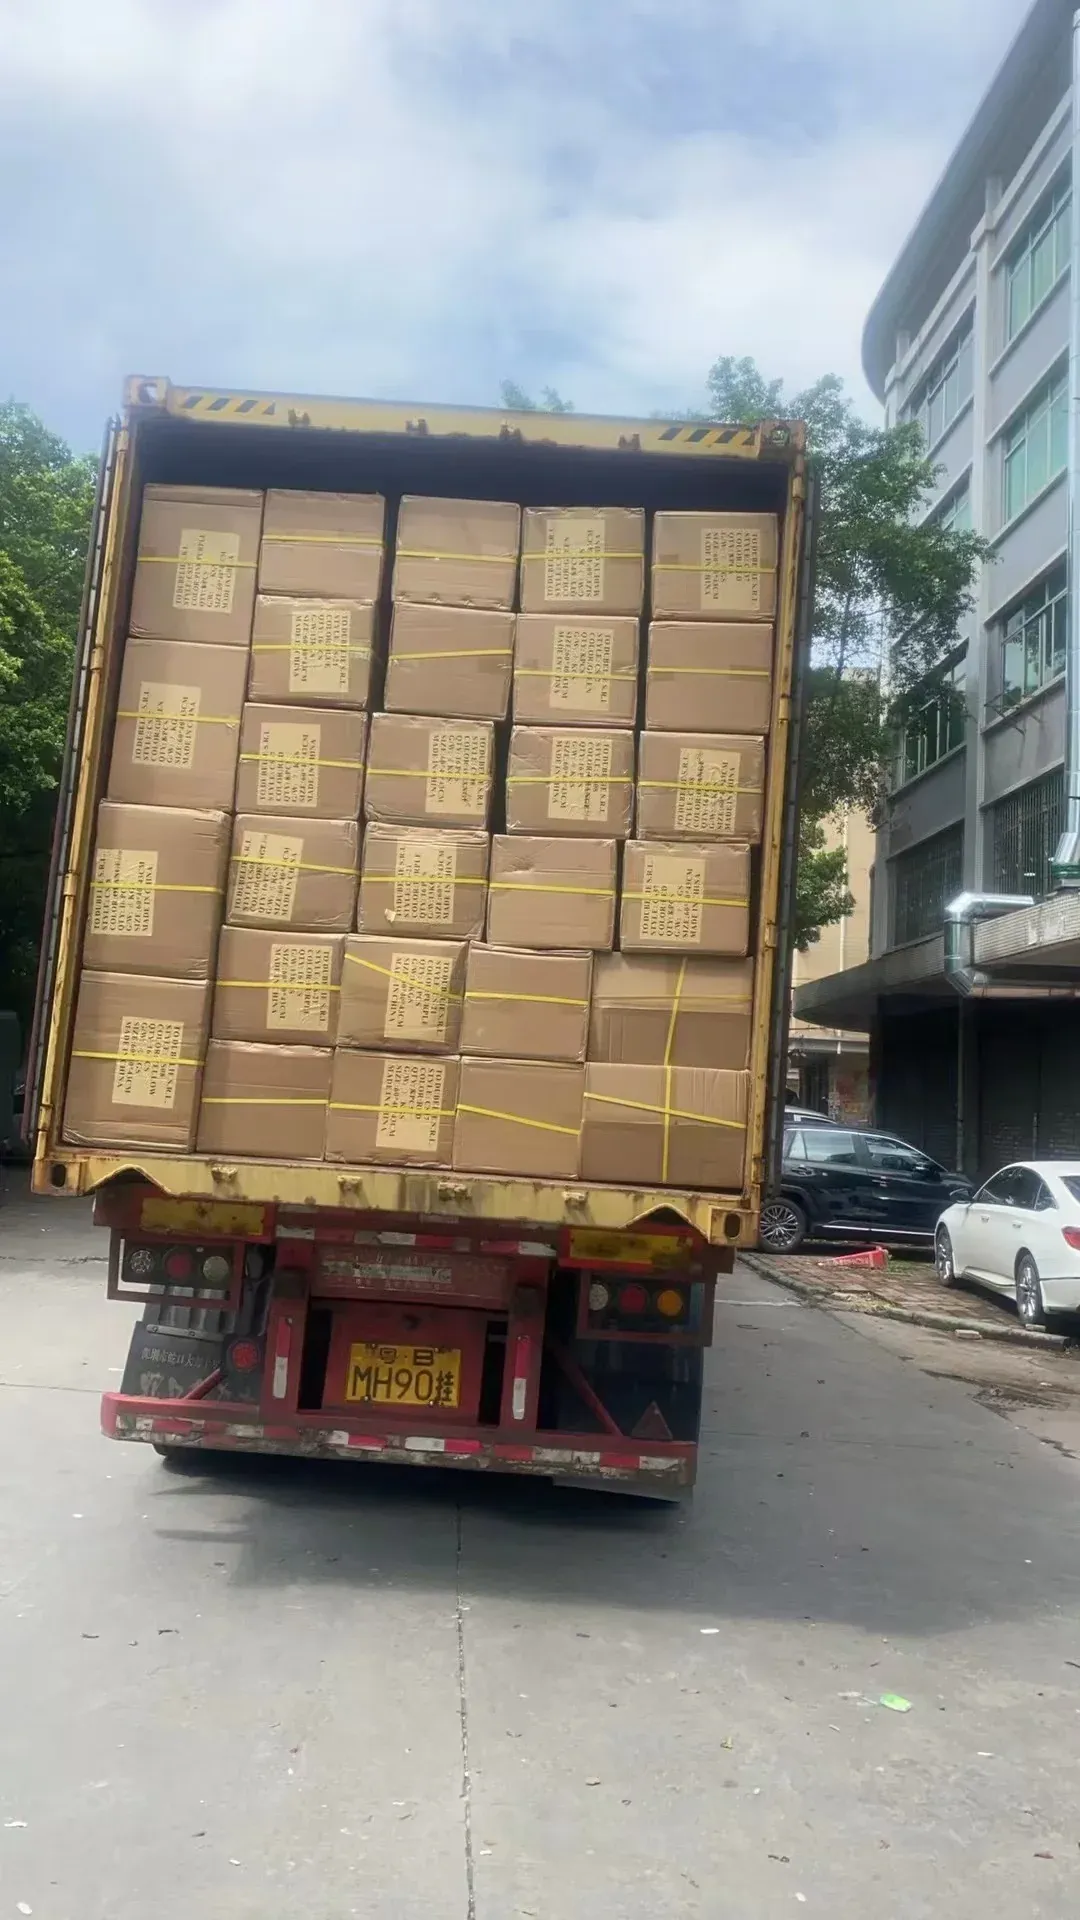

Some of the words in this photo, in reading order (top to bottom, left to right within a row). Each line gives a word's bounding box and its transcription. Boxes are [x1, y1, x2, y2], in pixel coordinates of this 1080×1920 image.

[136, 710, 146, 746] DUBELI
[150, 700, 163, 761] COLOR:GREN
[186, 701, 195, 728] CINA
[600, 756, 608, 791] DUBEIE
[287, 852, 297, 879] CHNA
[95, 880, 103, 916] DUBELE
[396, 868, 404, 903] DUBEIE
[692, 873, 700, 897] HINA
[643, 886, 651, 921] DUBEIE
[320, 963, 328, 999] DUBEIE
[438, 975, 448, 1011] DUBLIE
[389, 994, 397, 1022] CHINA
[149, 1023, 164, 1095] COLOR:ELLOW
[167, 1039, 178, 1075] DUBLIE
[431, 1082, 440, 1119] DUBELE
